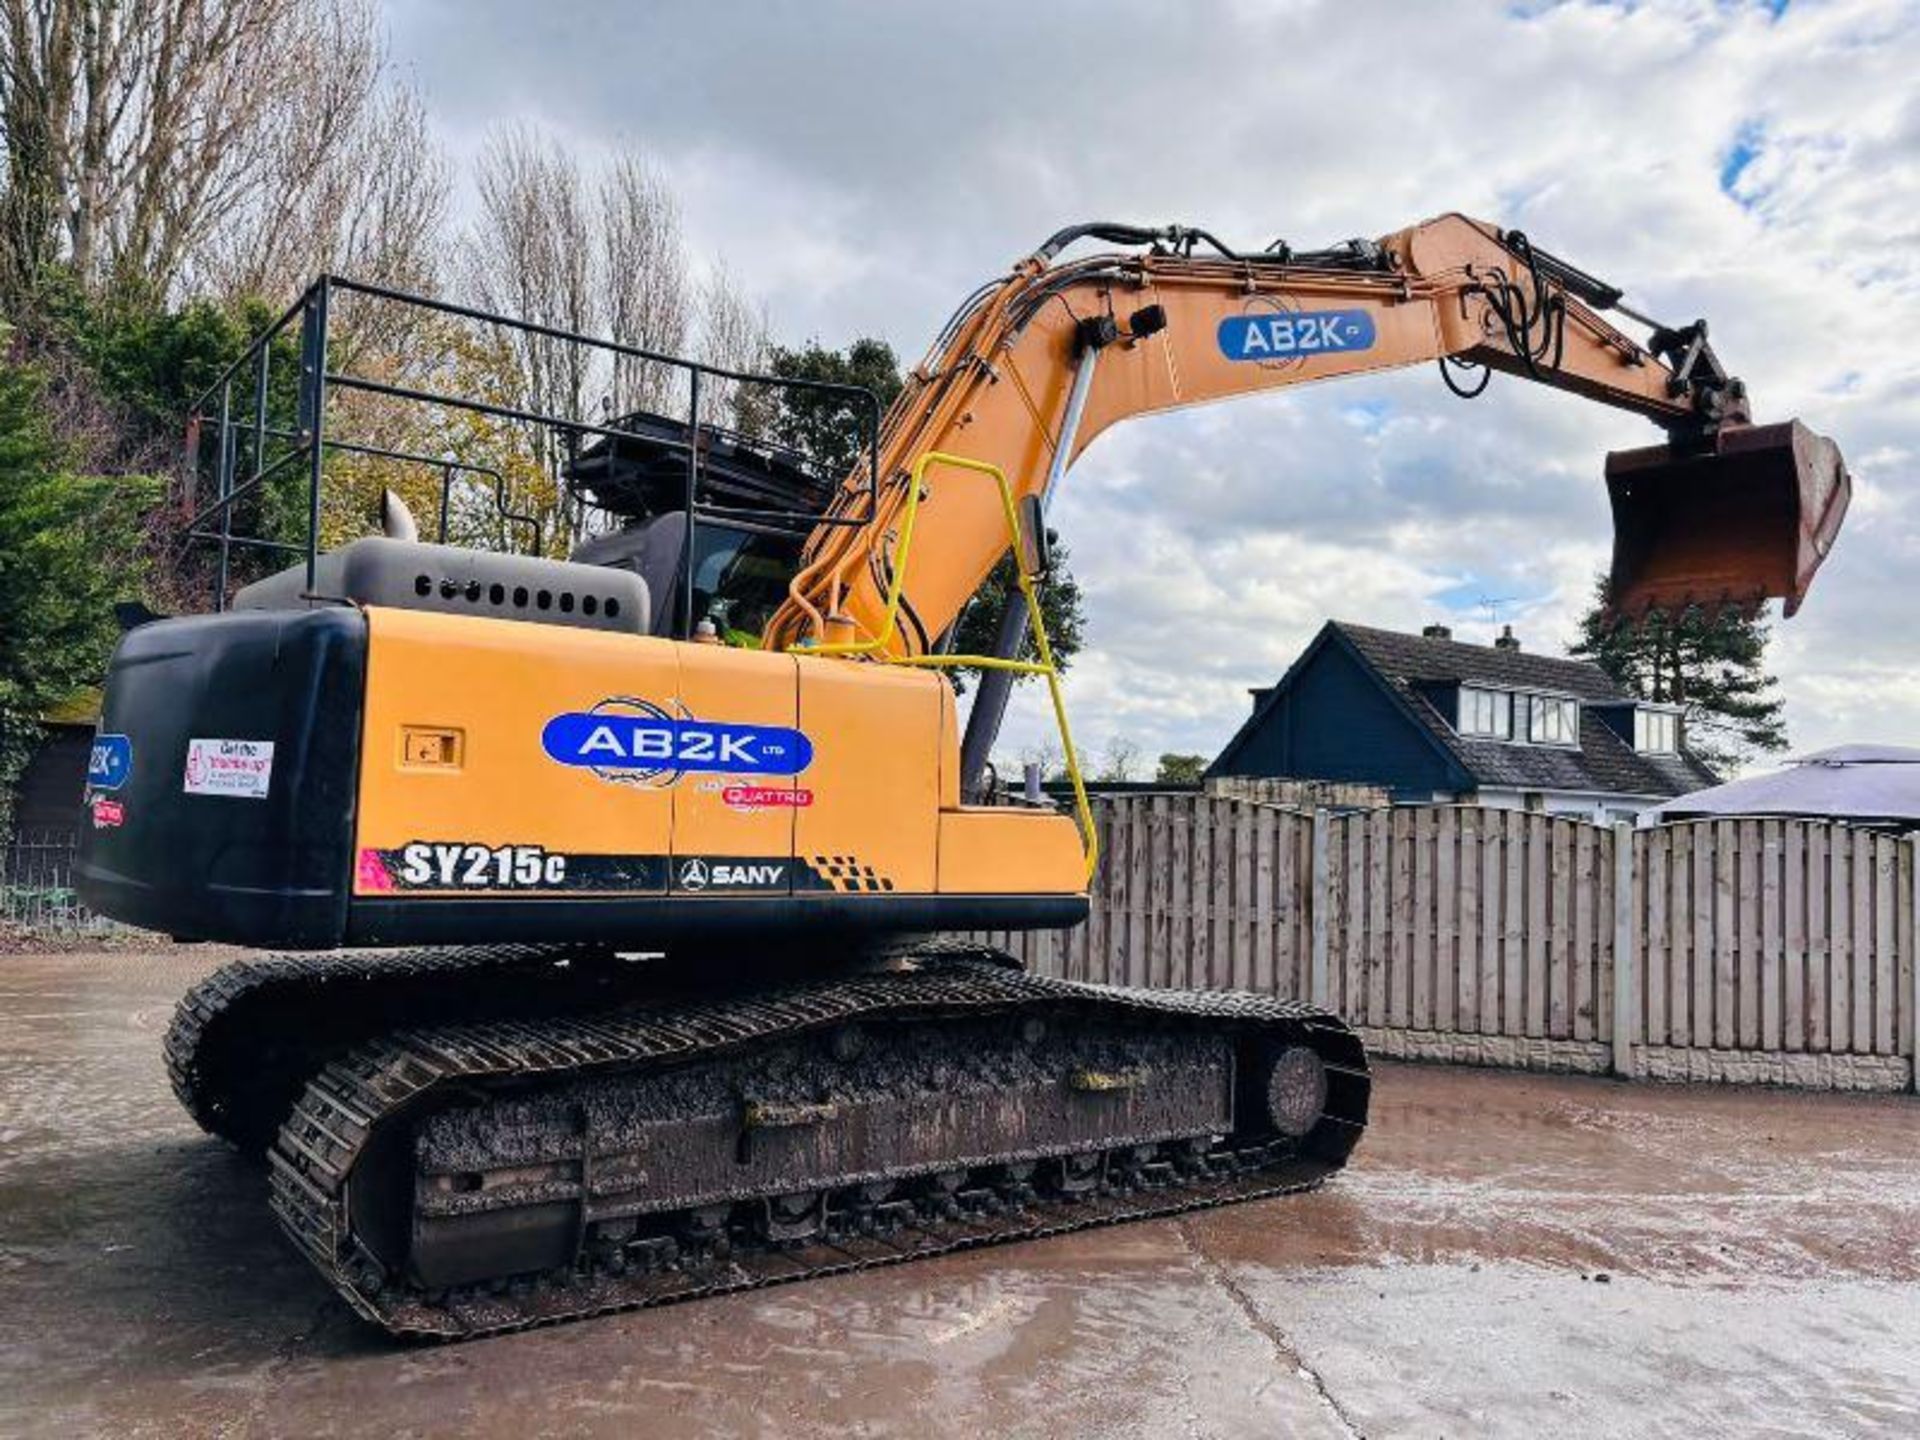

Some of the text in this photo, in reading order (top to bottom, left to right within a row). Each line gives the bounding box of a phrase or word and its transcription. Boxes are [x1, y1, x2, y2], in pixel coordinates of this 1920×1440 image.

[1243, 316, 1344, 353] AB2K
[578, 726, 759, 764] AB2K
[727, 789, 807, 804] QUATTRO
[712, 865, 784, 884] SANY
